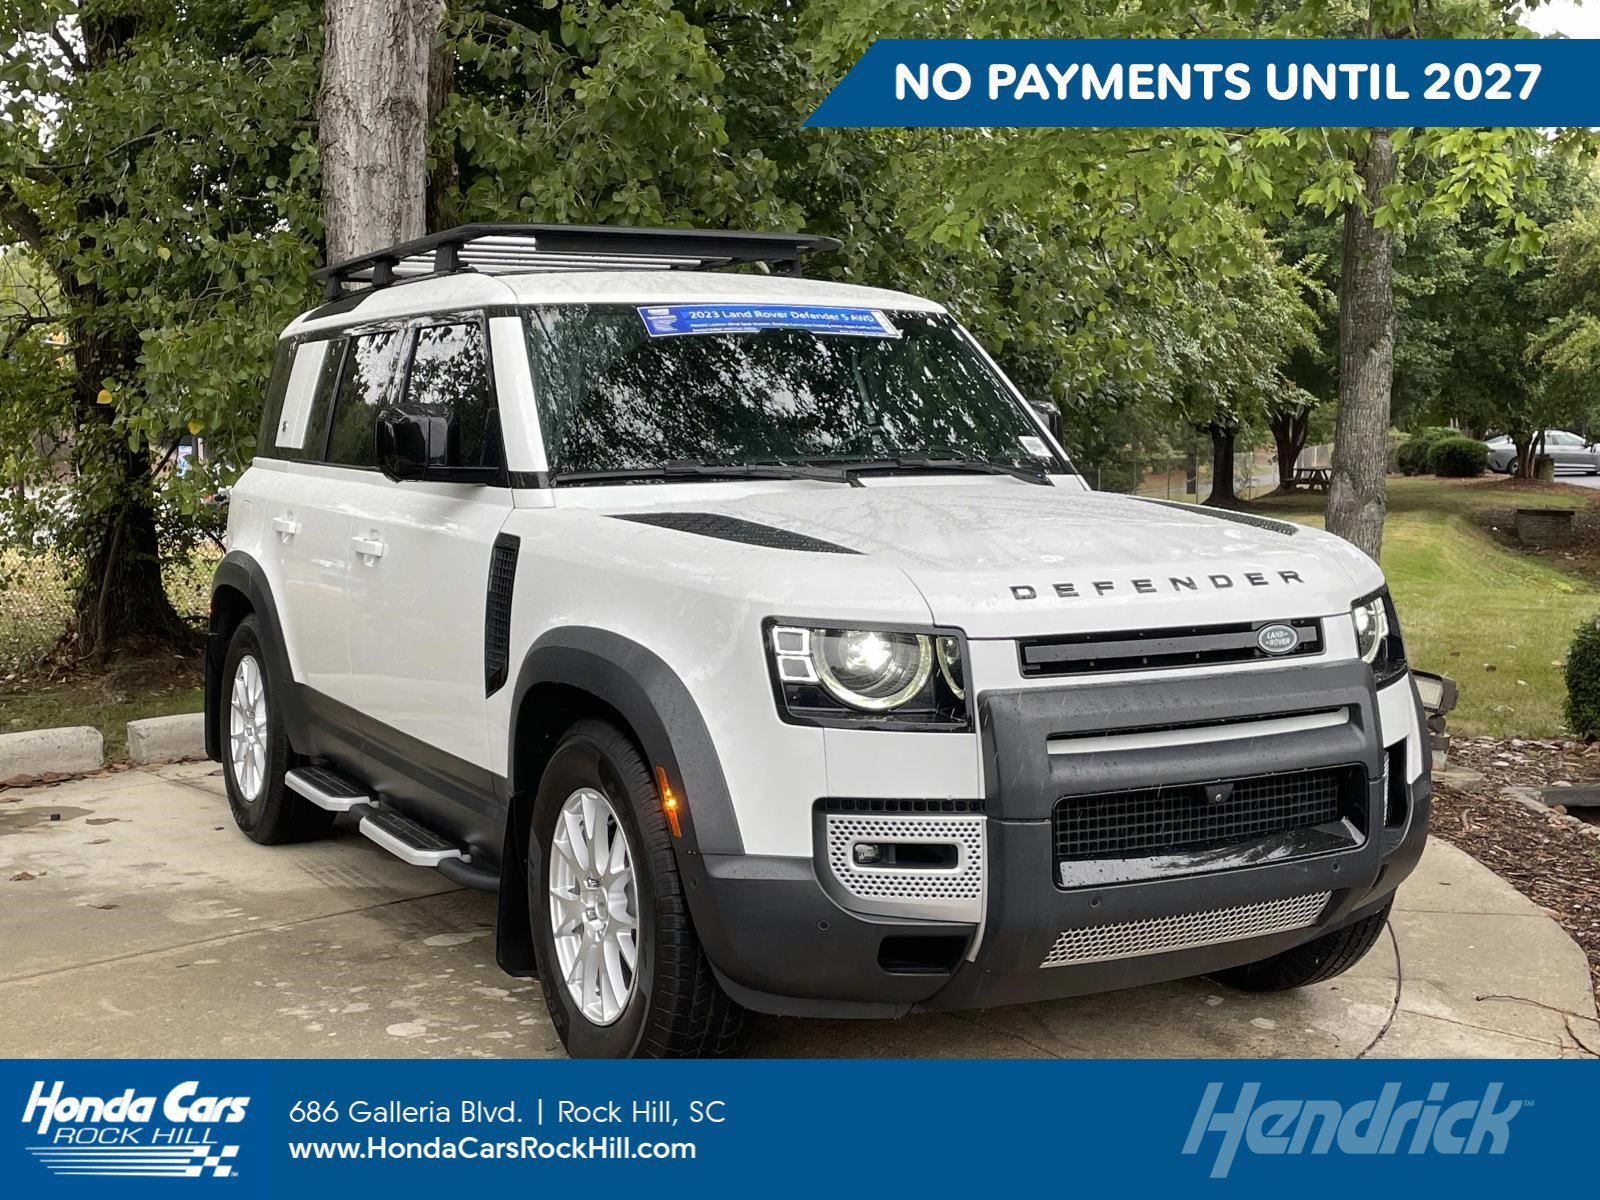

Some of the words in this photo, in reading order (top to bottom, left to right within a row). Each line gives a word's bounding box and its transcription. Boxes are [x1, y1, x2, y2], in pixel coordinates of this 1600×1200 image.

[689, 311, 720, 319] 2023
[721, 310, 752, 318] Land
[753, 310, 788, 319] Rover
[790, 311, 839, 320] Defender
[850, 314, 875, 322] AWD
[1009, 570, 1305, 600] DEFENDER
[1266, 631, 1285, 639] LAND
[1270, 638, 1291, 646] ROVER
